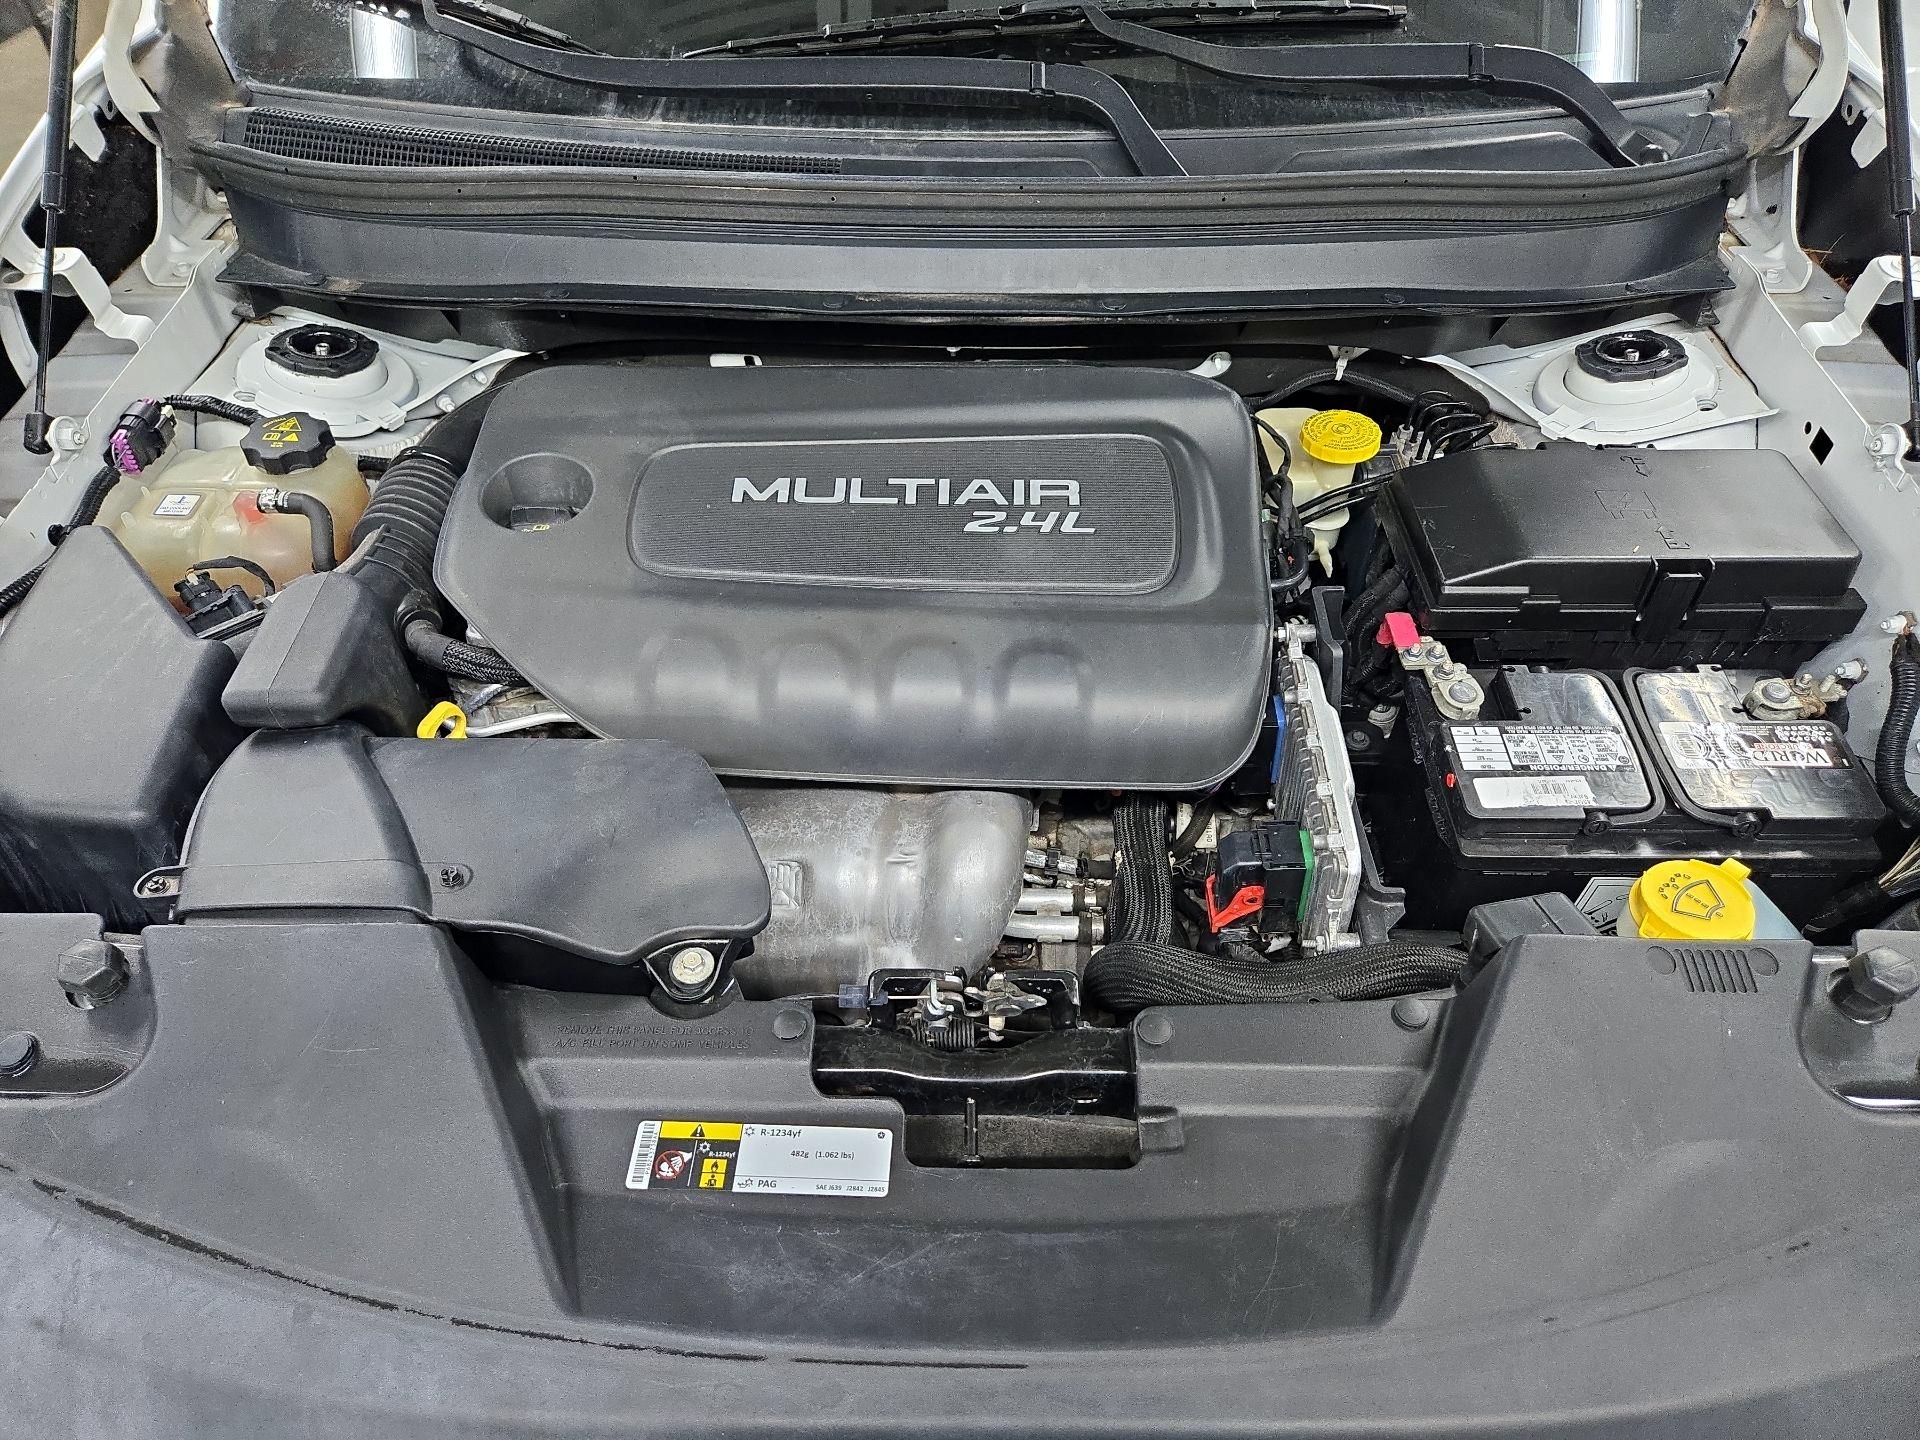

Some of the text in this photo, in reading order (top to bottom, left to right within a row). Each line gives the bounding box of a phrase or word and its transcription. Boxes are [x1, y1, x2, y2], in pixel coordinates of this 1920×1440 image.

[731, 477, 1081, 506] MULTIAIR
[962, 511, 1096, 534] 2.4L
[633, 1026, 667, 1036] PANEL
[760, 1128, 802, 1138] R-1234yf
[790, 1150, 855, 1160] 482g (1.062 lbs)
[757, 1179, 778, 1188] PAG
